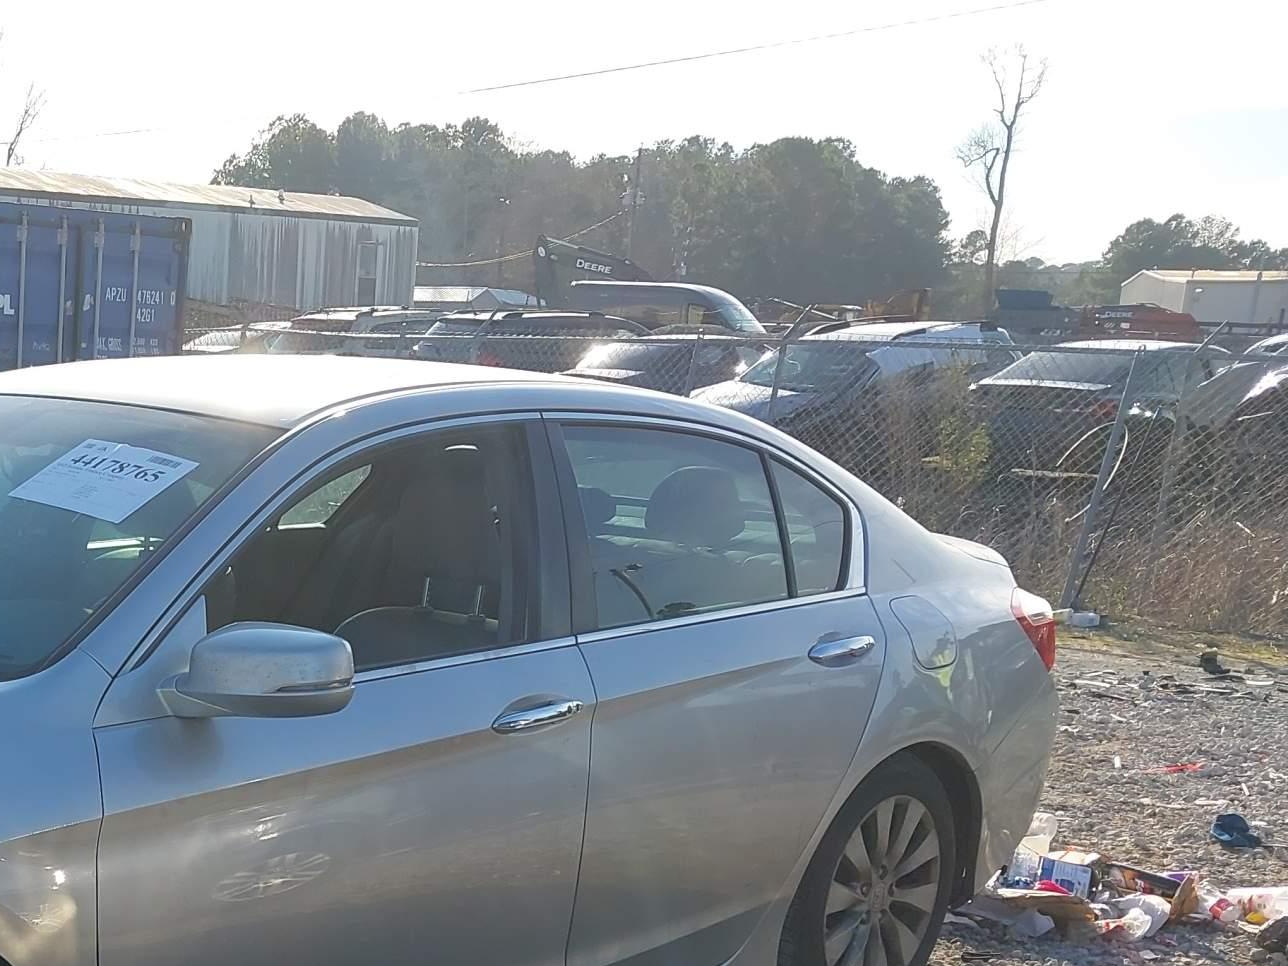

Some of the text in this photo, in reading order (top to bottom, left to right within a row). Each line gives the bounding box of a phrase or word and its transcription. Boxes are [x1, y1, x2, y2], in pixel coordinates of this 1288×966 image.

[576, 258, 612, 274] DEERE
[105, 287, 127, 302] APZU
[137, 289, 164, 305] 476241
[136, 308, 155, 322] 42G1
[70, 454, 166, 483] 44178765
